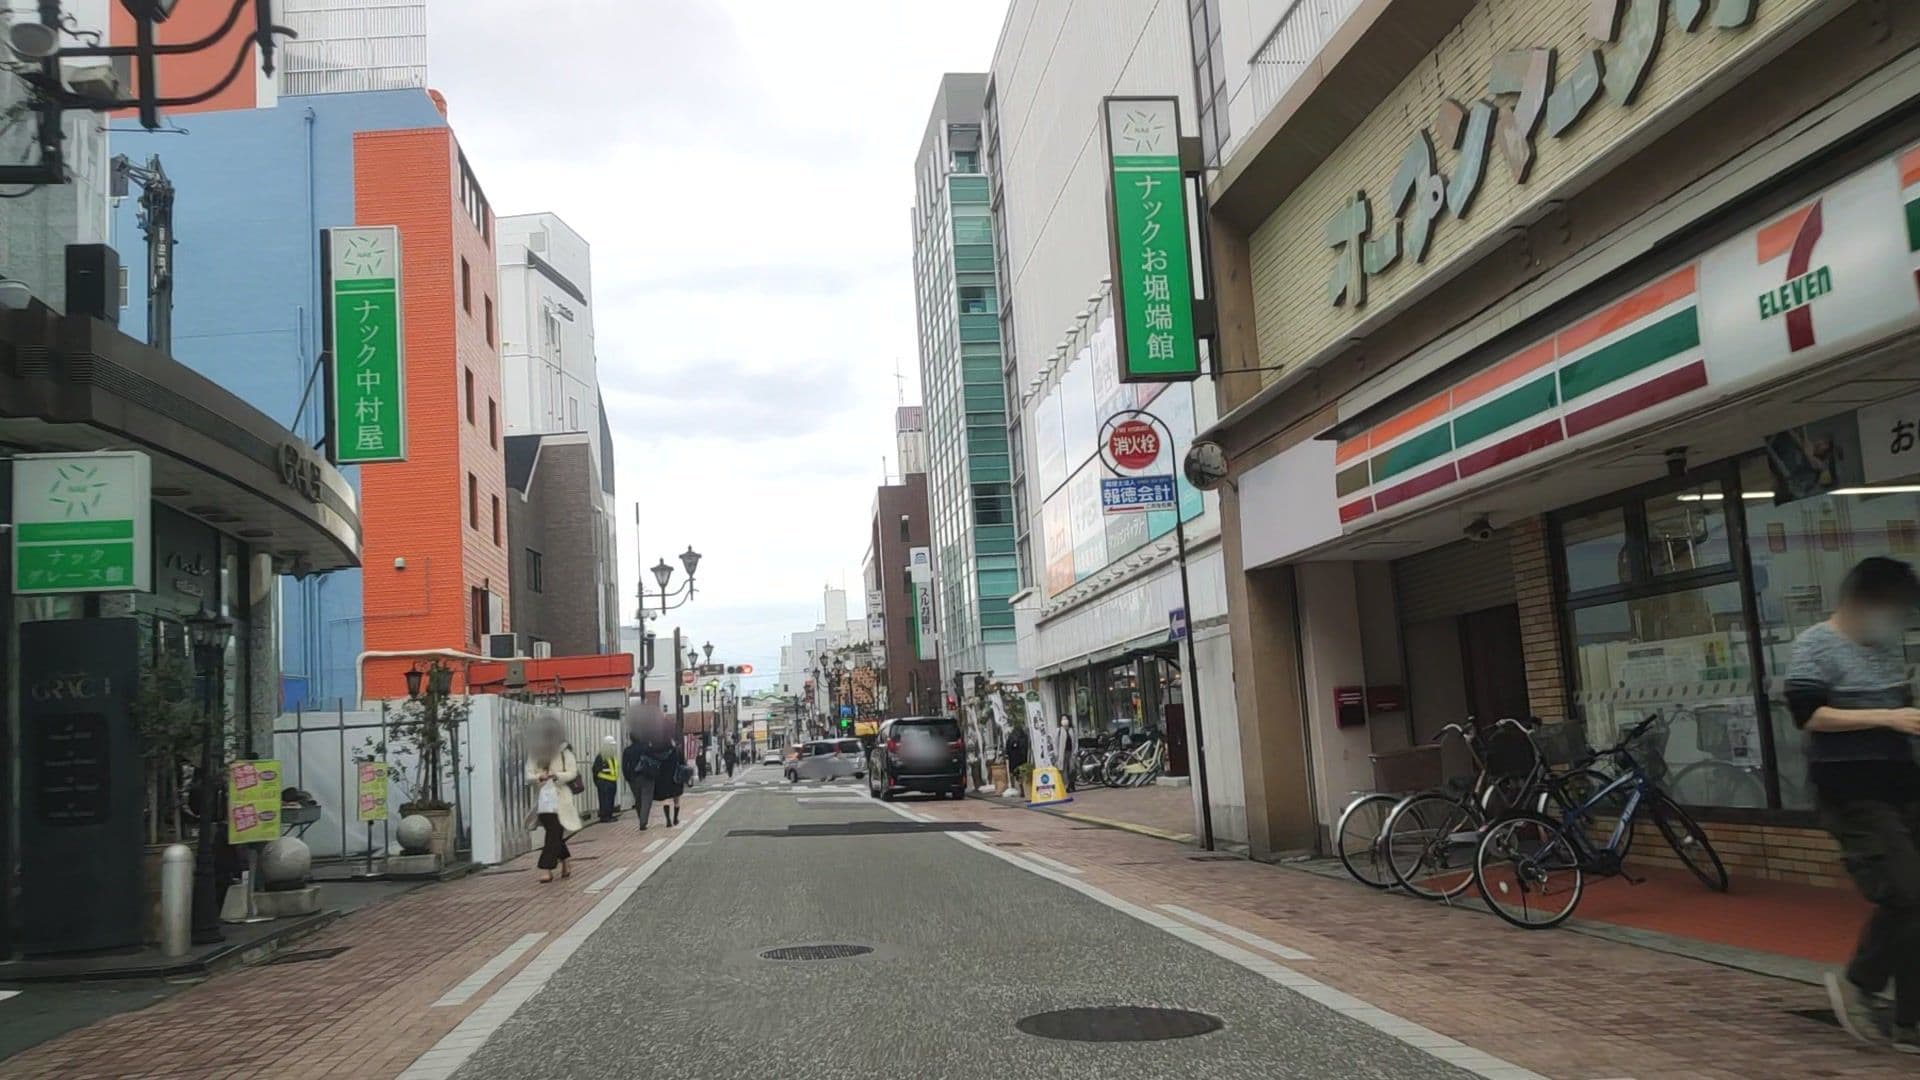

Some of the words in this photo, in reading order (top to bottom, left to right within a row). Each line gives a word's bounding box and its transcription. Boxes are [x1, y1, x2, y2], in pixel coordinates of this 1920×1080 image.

[1135, 175, 1175, 361] ナックお堀端館
[353, 300, 384, 451] ナック中村屋
[1112, 433, 1157, 456] 消火栓
[1889, 419, 1920, 455] お
[1103, 484, 1171, 504] 報徳会計
[48, 549, 104, 565] ナック
[920, 586, 931, 635] スルガ銀行
